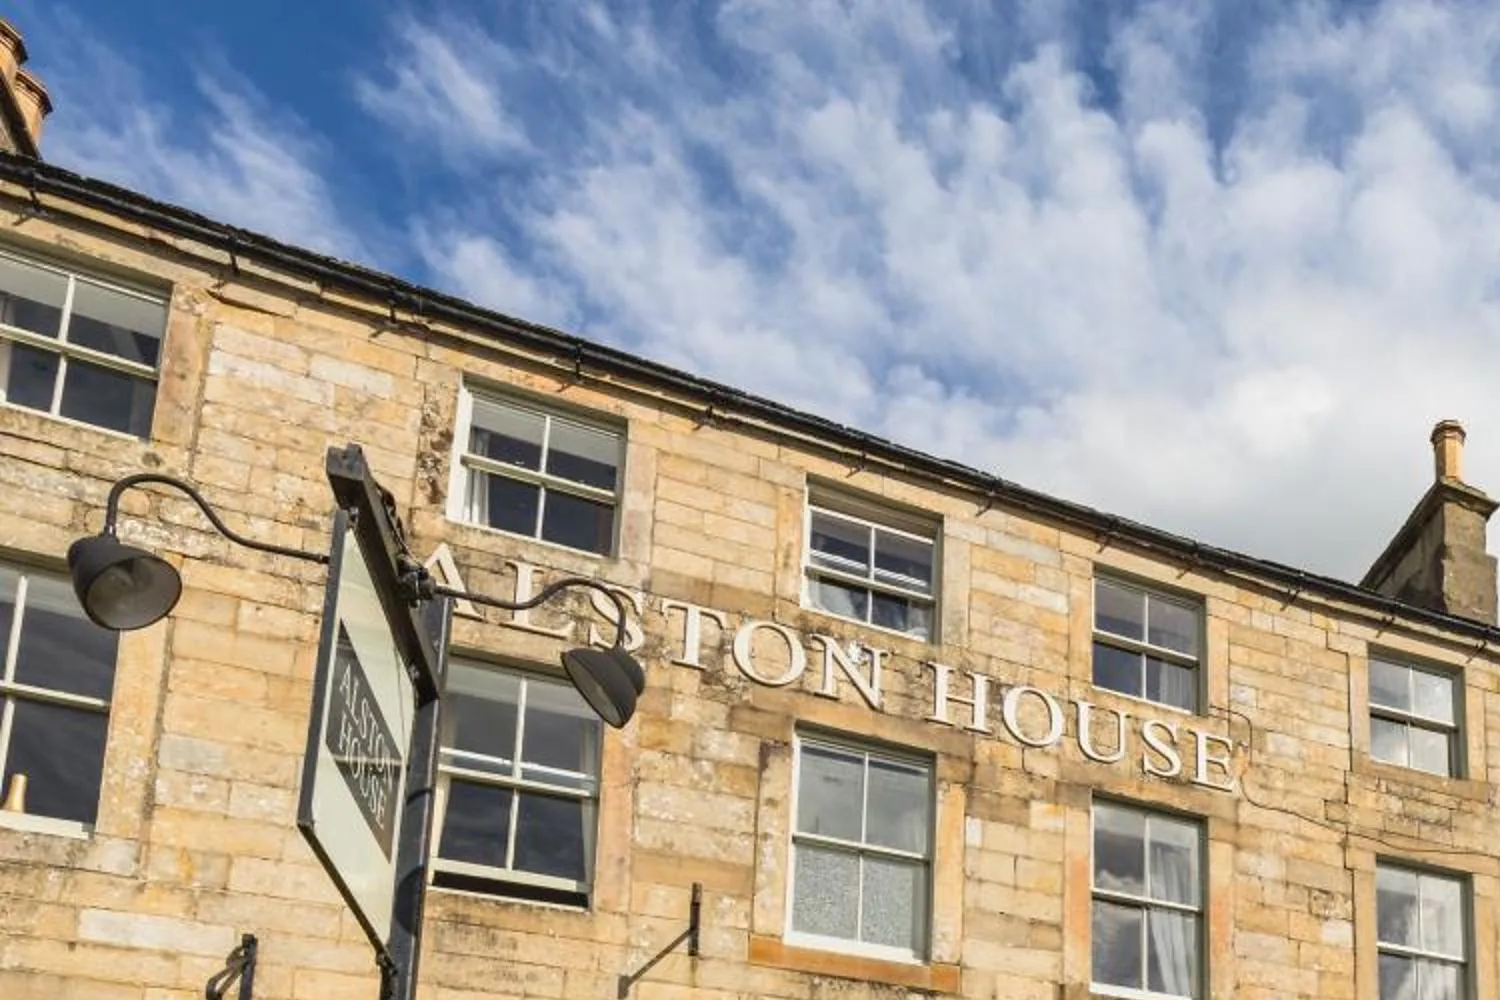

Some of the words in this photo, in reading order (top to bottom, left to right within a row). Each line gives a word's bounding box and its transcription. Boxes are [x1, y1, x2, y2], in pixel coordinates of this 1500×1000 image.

[339, 663, 394, 793] ALSTON
[422, 543, 890, 712] ALSTON
[926, 661, 1237, 792] HOUSE
[338, 712, 386, 830] HOUSE
